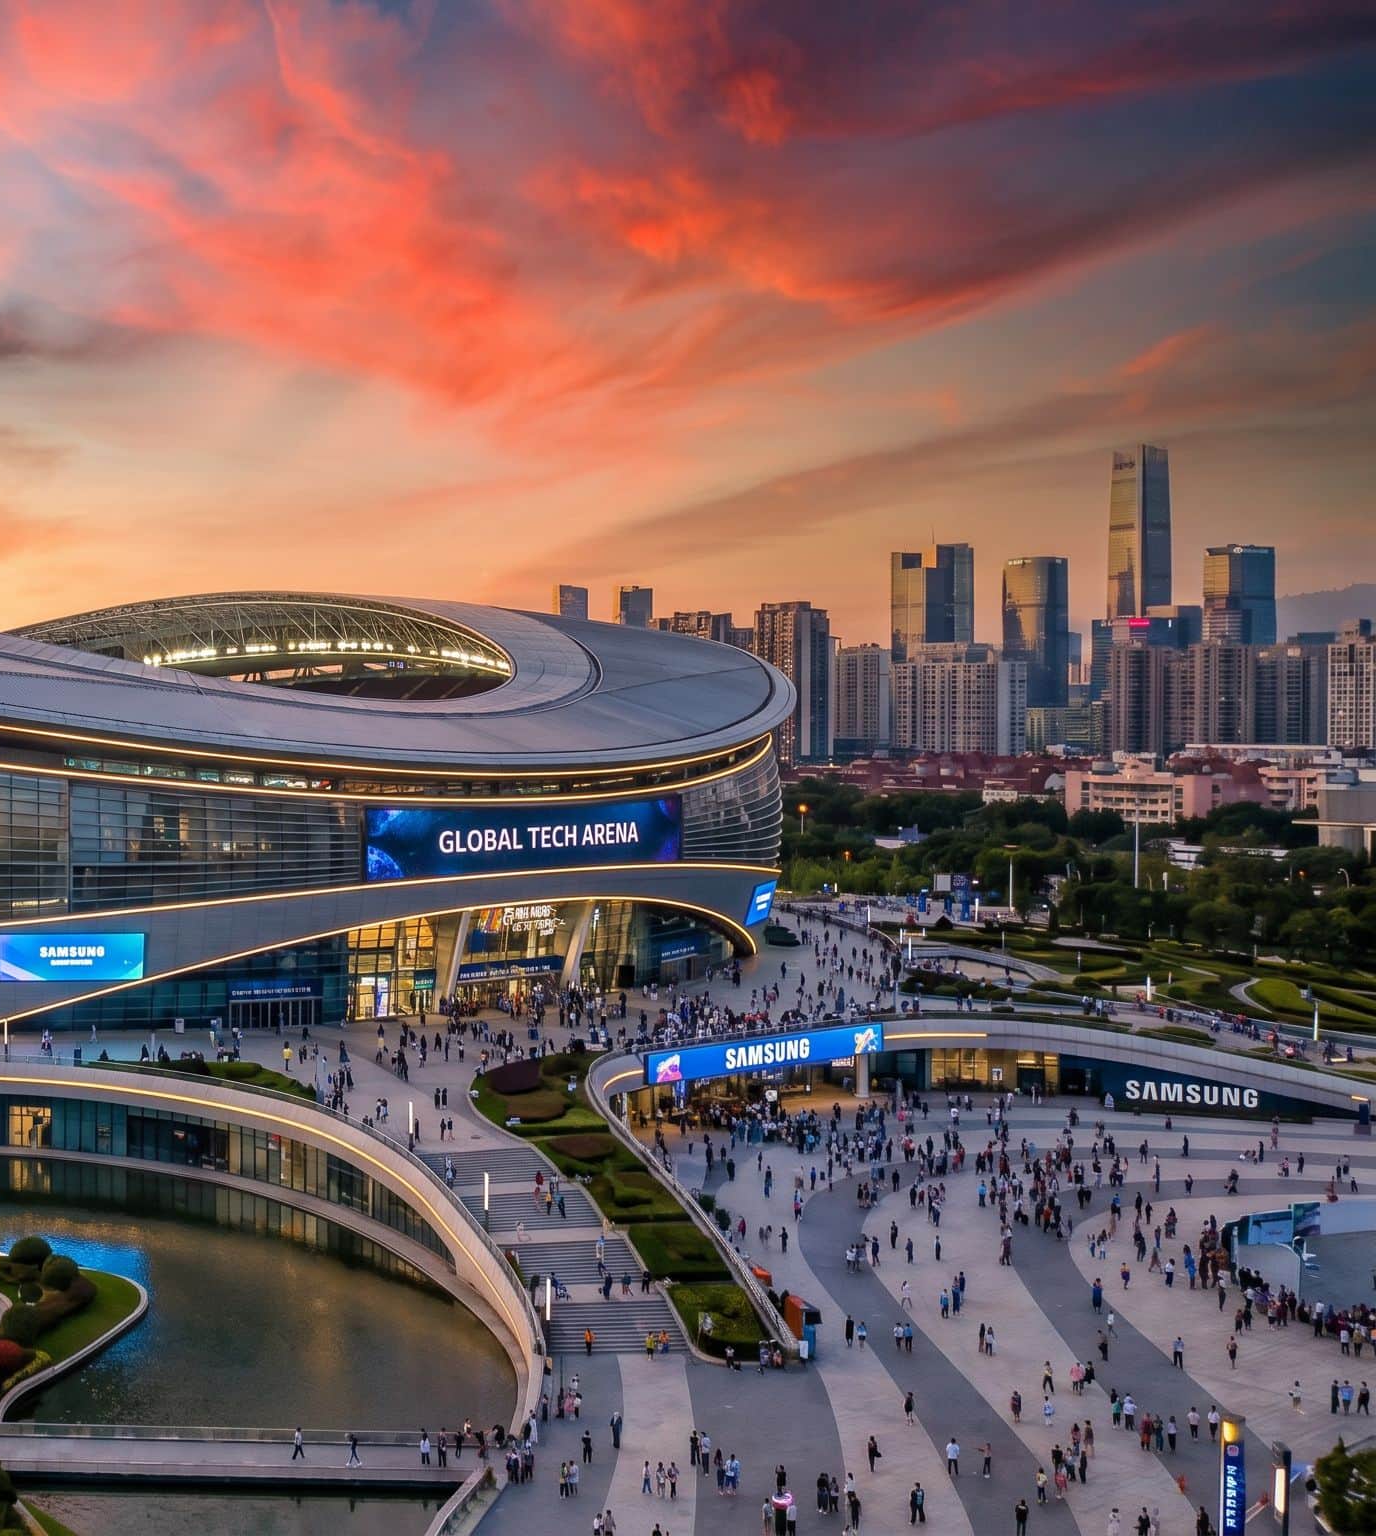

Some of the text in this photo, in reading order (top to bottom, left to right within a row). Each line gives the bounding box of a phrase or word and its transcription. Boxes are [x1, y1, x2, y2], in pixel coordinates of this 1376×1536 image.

[438, 821, 639, 854] GLOBAL TECH ARENA
[39, 946, 105, 958] SAMSUNG
[725, 1038, 810, 1069] SAMSUNG
[1125, 1079, 1259, 1108] SAMSUNG
